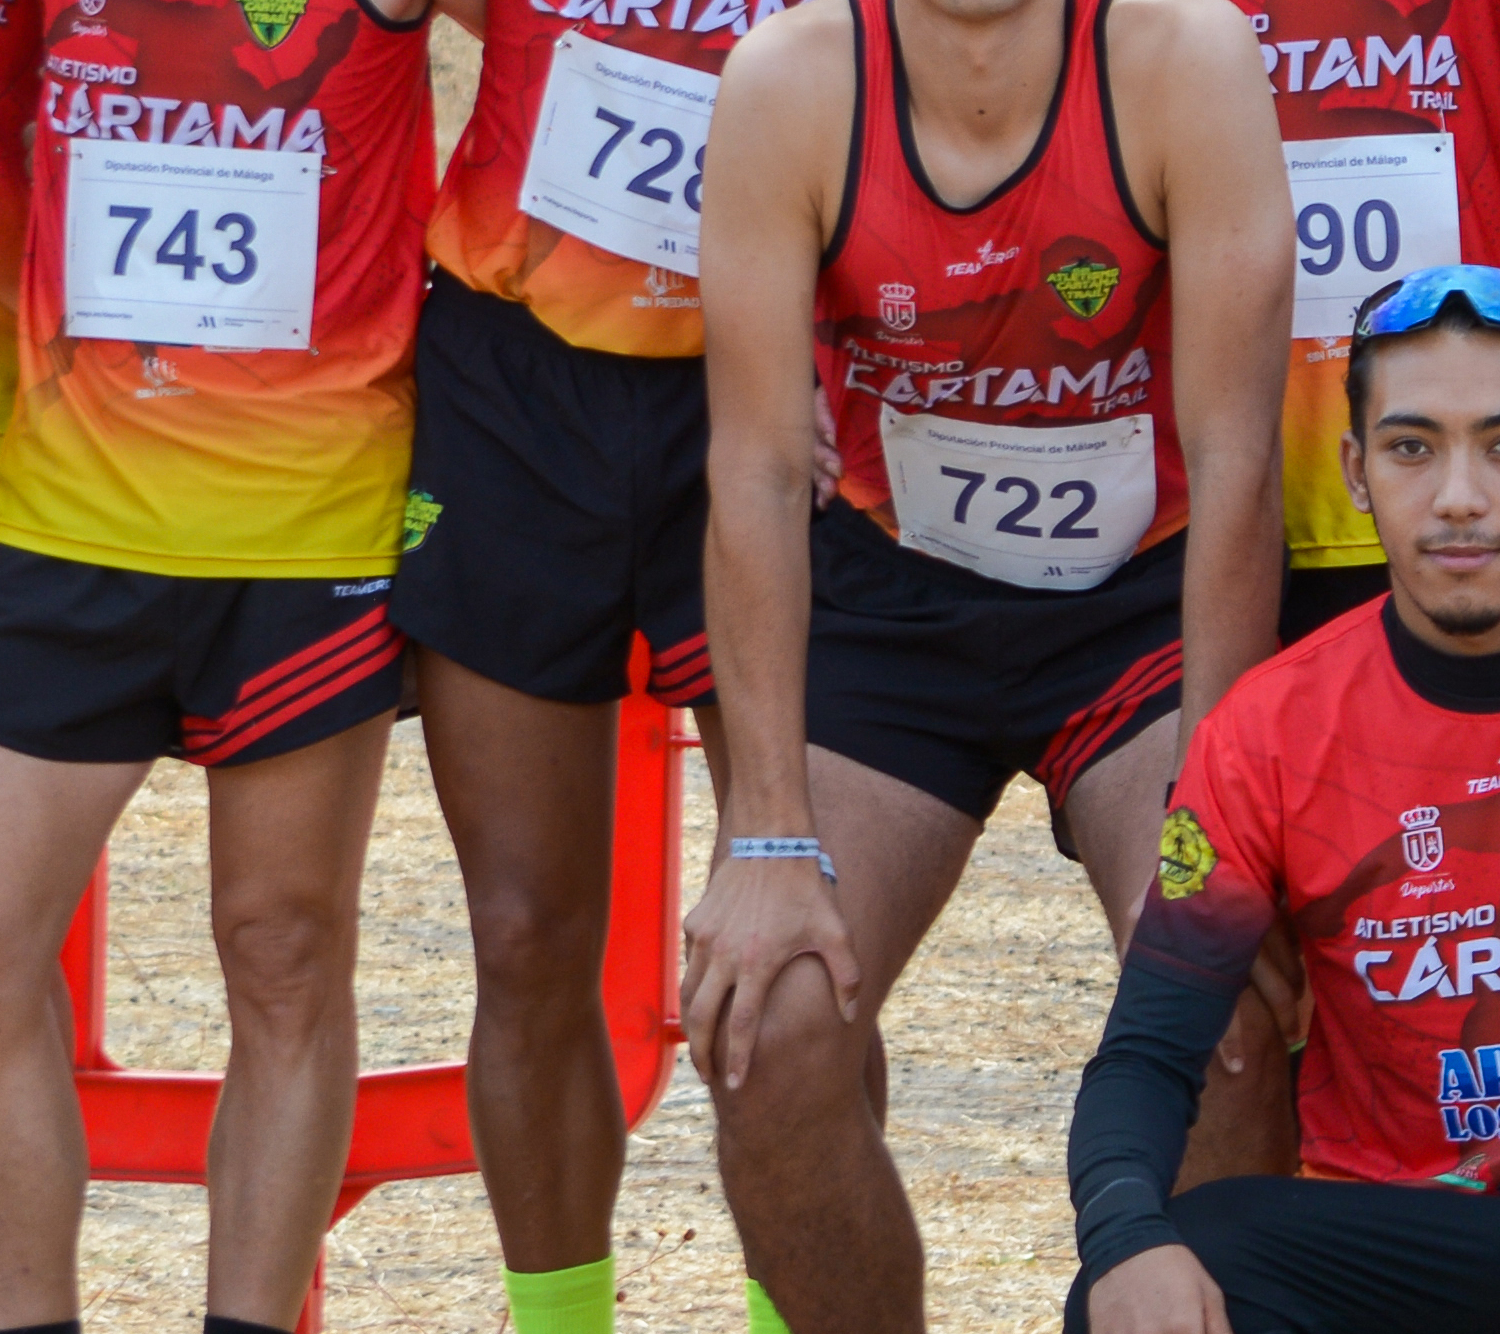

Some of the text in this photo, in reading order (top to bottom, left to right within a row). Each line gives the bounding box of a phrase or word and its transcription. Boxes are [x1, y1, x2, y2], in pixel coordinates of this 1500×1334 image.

[47, 55, 137, 86] LETISMO
[595, 61, 707, 104] Diputación Provincial
[105, 159, 160, 174] Diputación
[162, 164, 215, 178] Provincial
[216, 167, 231, 178] de
[1291, 153, 1408, 171] Provincial de Málaga
[108, 204, 259, 286] 743
[1296, 198, 1401, 276] 90
[655, 296, 701, 309] PIEDAD
[927, 428, 988, 449] Diputación
[989, 440, 1047, 454] Provincial
[1048, 443, 1063, 454] de
[940, 464, 1100, 539] 722
[1399, 878, 1456, 900] Deportes
[1353, 903, 1496, 941] ATLETISMO
